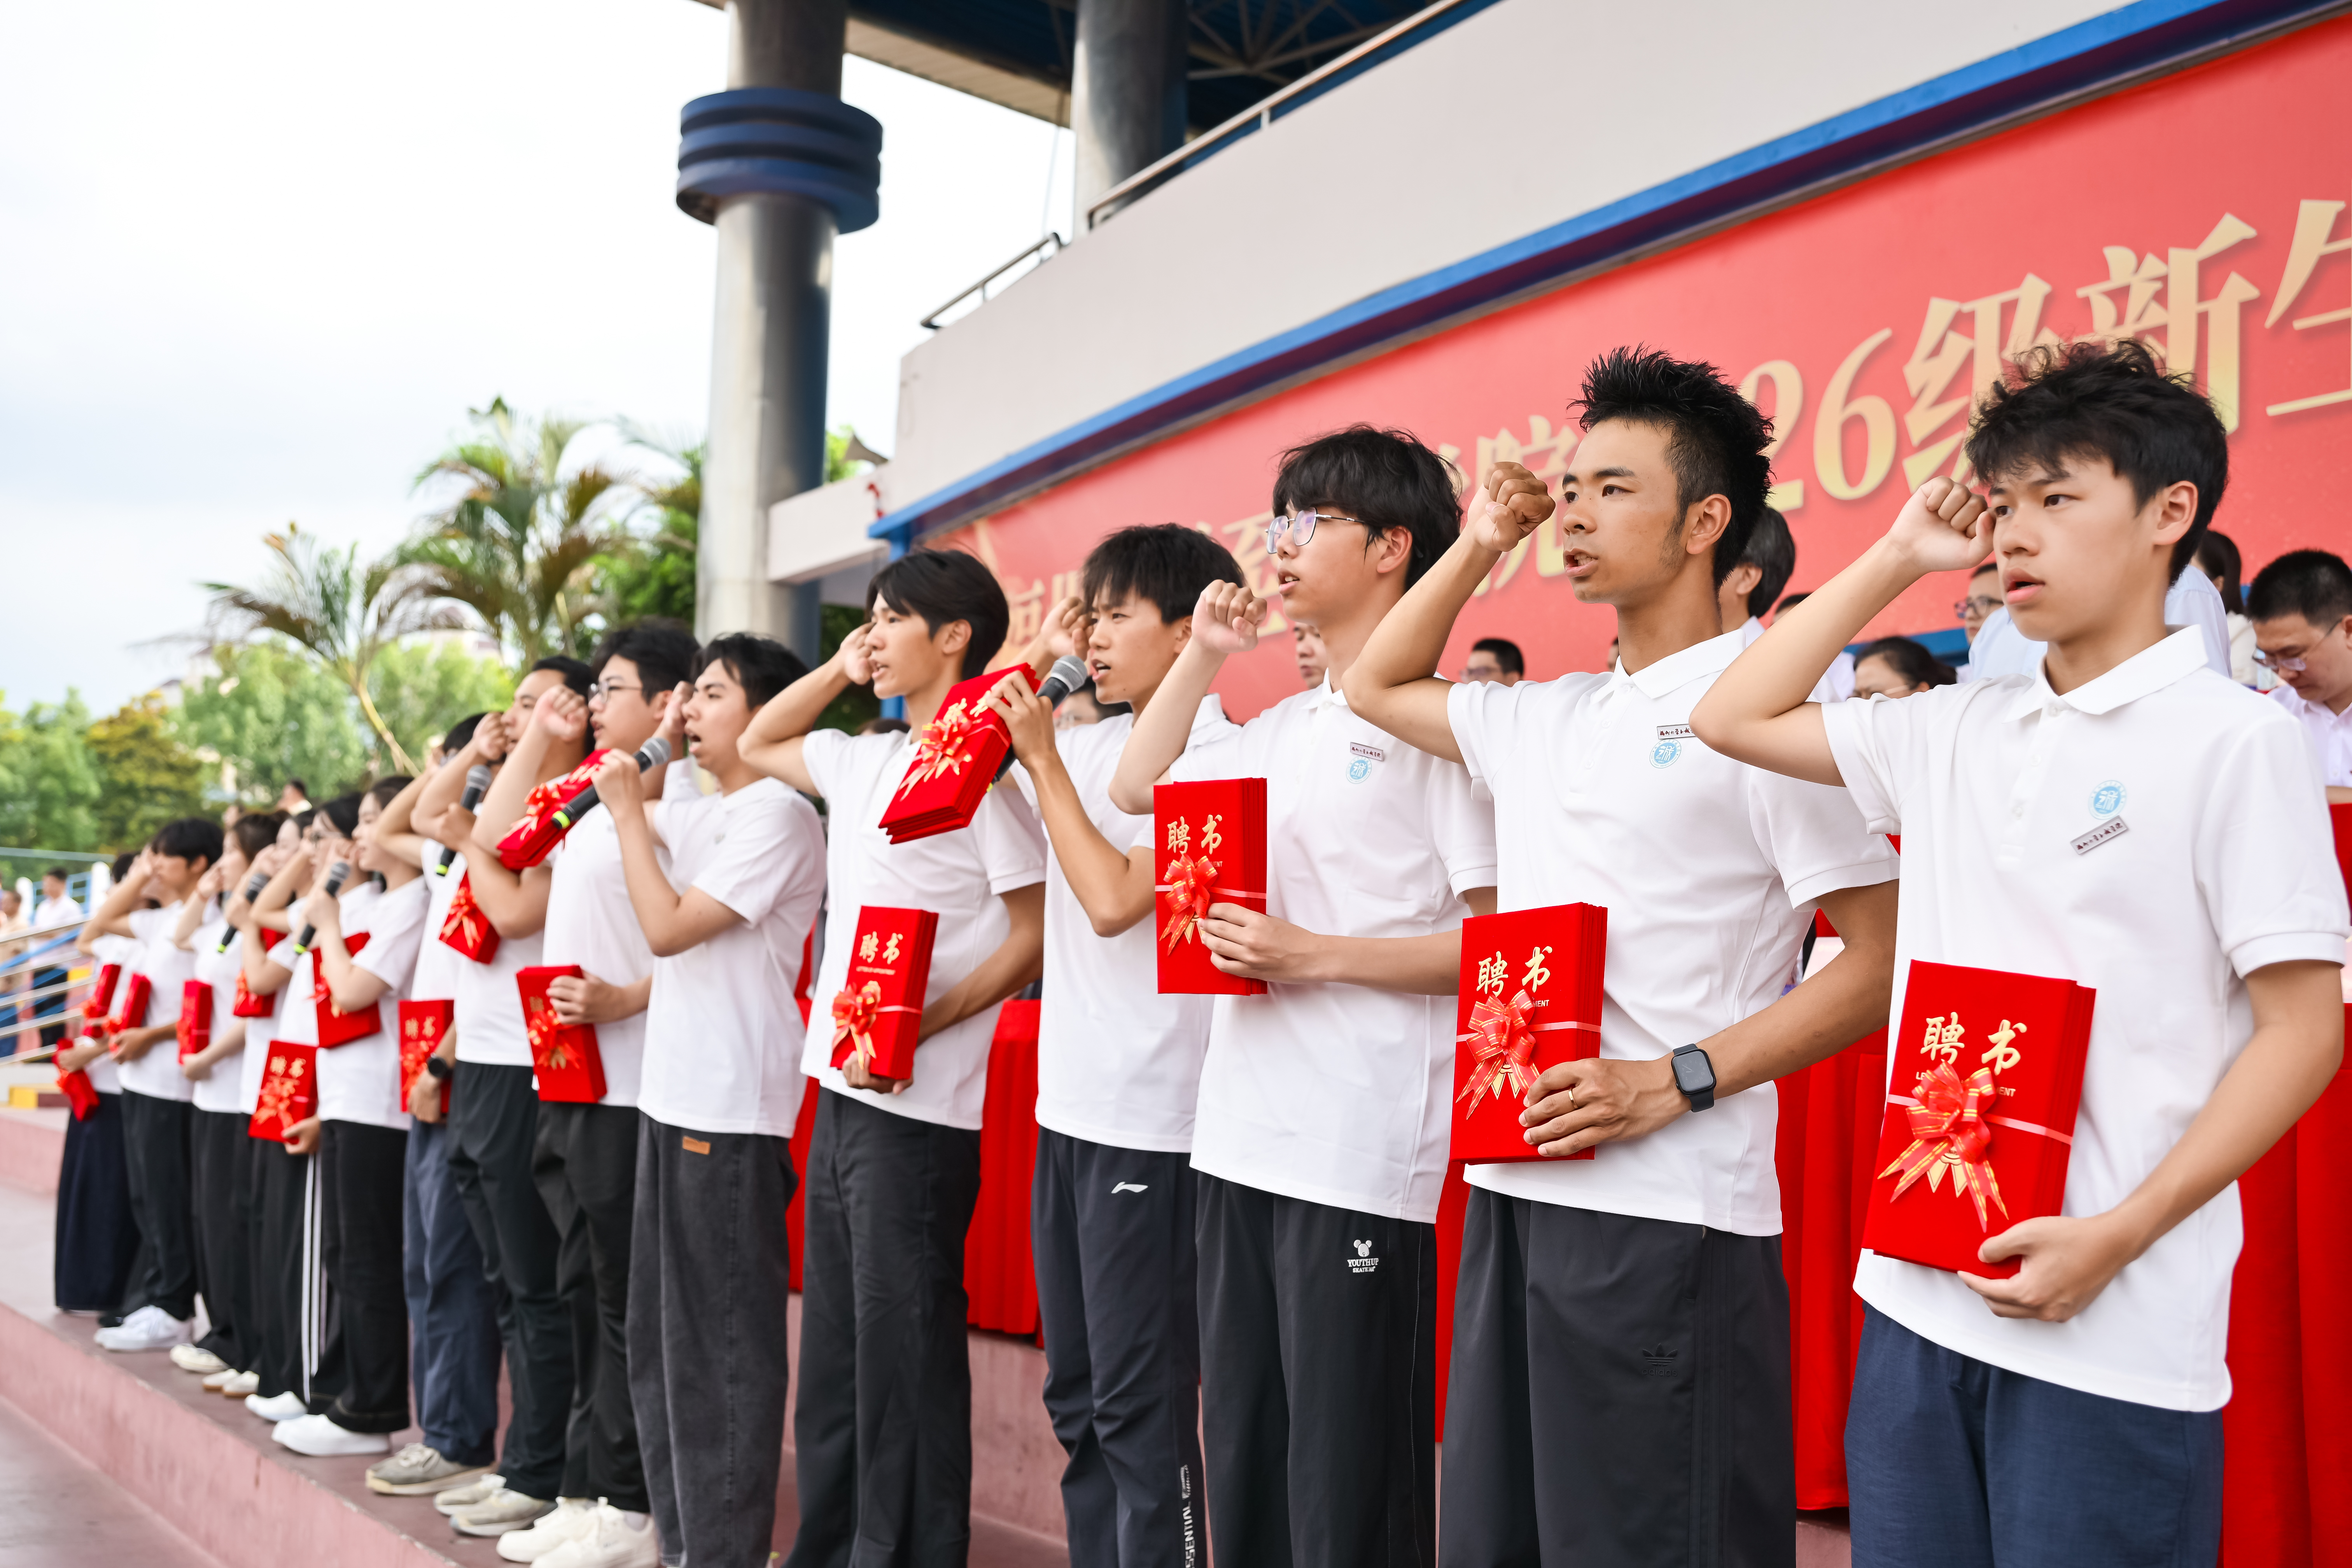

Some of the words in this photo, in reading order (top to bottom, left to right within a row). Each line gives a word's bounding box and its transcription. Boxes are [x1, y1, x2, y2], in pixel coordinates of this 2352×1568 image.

[1167, 814, 1223, 854] 聘书
[859, 931, 903, 964] 聘书
[1476, 946, 1552, 997] 聘书
[1920, 1012, 2027, 1076] 聘书
[1347, 1258, 1379, 1267] YOUTHUP
[1642, 1368, 1678, 1377] adidas
[1183, 1501, 1195, 1568] SSENTIAL
